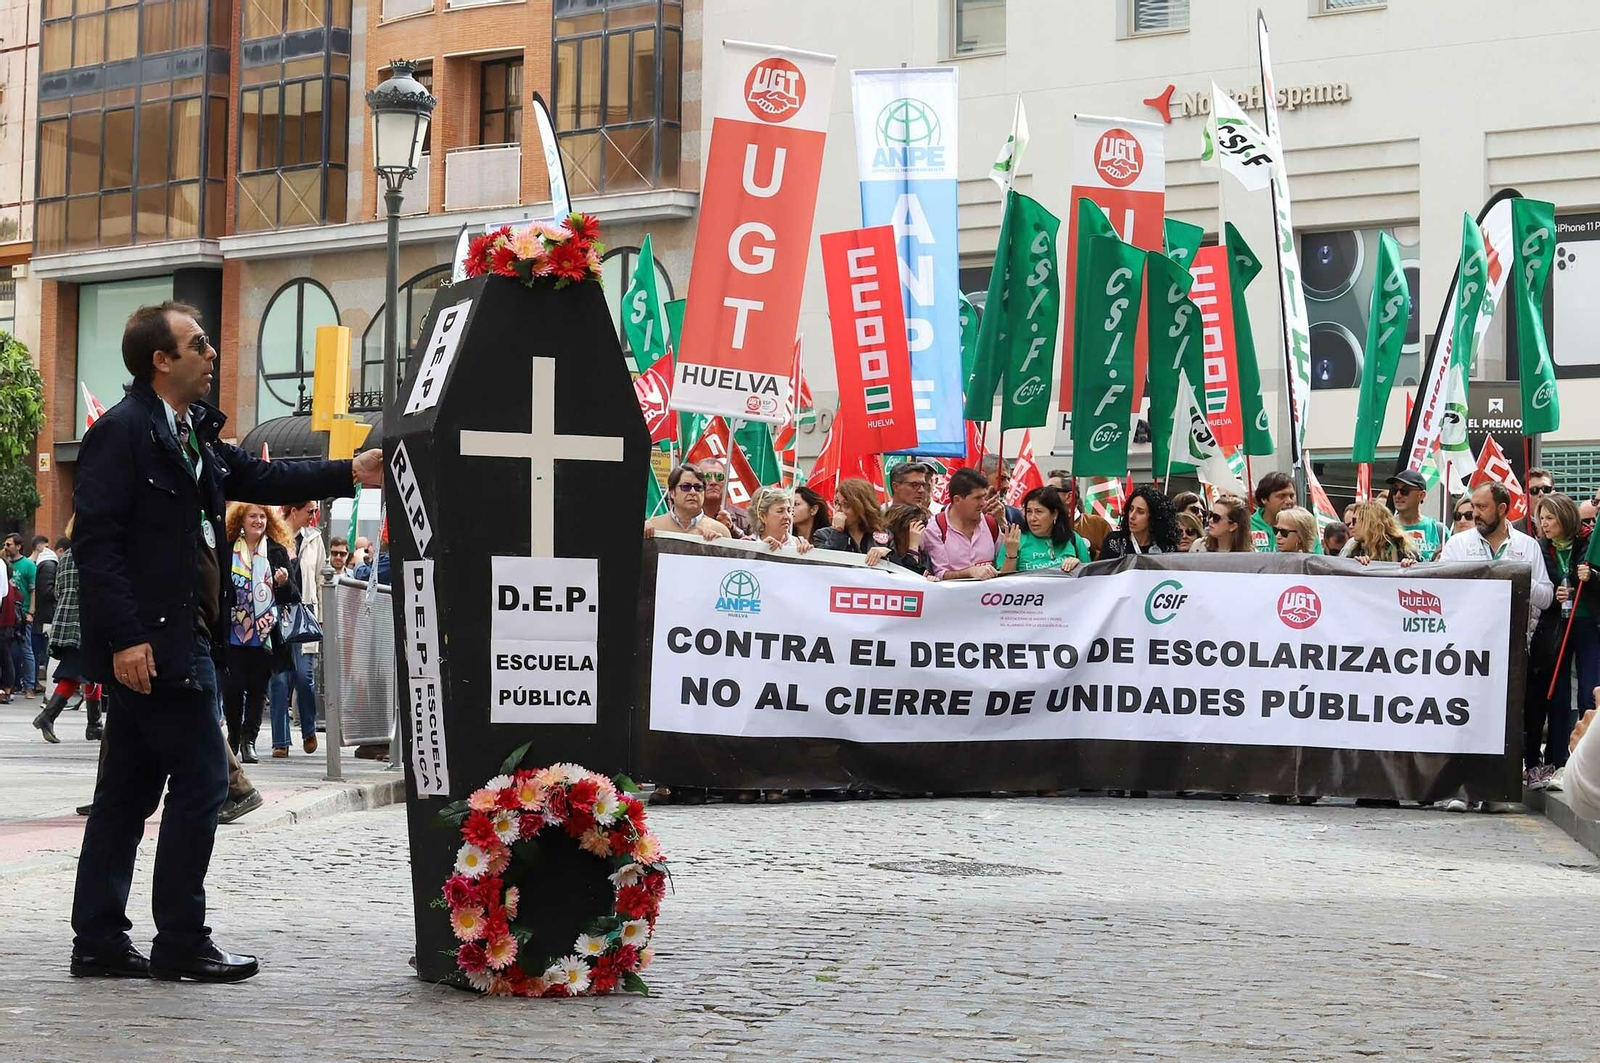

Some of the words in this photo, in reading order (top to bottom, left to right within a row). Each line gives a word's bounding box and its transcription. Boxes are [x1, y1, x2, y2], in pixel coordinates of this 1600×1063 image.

[752, 66, 800, 96] UGT
[872, 146, 945, 167] ANPE
[1100, 137, 1137, 162] UGT
[1557, 223, 1586, 233] iPhone
[1586, 221, 1594, 231] 11
[722, 143, 788, 350] UGT
[847, 246, 890, 381] CCOO
[681, 365, 780, 396] HUELVA
[866, 418, 895, 429] HUELVA
[1207, 418, 1232, 427] HUELVA
[1468, 419, 1480, 428] EL
[1482, 418, 1523, 429] PREMIO
[1032, 551, 1046, 559] Por
[498, 585, 597, 613] D.E.P.
[715, 597, 761, 612] ANPE
[836, 592, 901, 611] CCOO
[1153, 592, 1189, 610] CSIF
[1287, 592, 1317, 610] UGT
[1401, 596, 1441, 608] HUELVA
[1402, 617, 1447, 633] USTEA
[667, 626, 835, 664] CONTRA
[849, 638, 896, 668] EL
[910, 641, 1079, 670] DECRETO
[1086, 637, 1135, 664] DE
[1148, 638, 1490, 677] ESCOLARIZACIÓN
[496, 654, 595, 672] ESCUELA
[498, 685, 592, 706] PÚBLICA
[680, 677, 741, 708] NO
[755, 683, 809, 712] AL
[825, 687, 974, 716] CIERRE
[984, 690, 1037, 717] DE
[1045, 684, 1246, 717] UNIDADES
[1261, 684, 1470, 726] PÚBLICAS
[427, 683, 443, 792] ESCUELA
